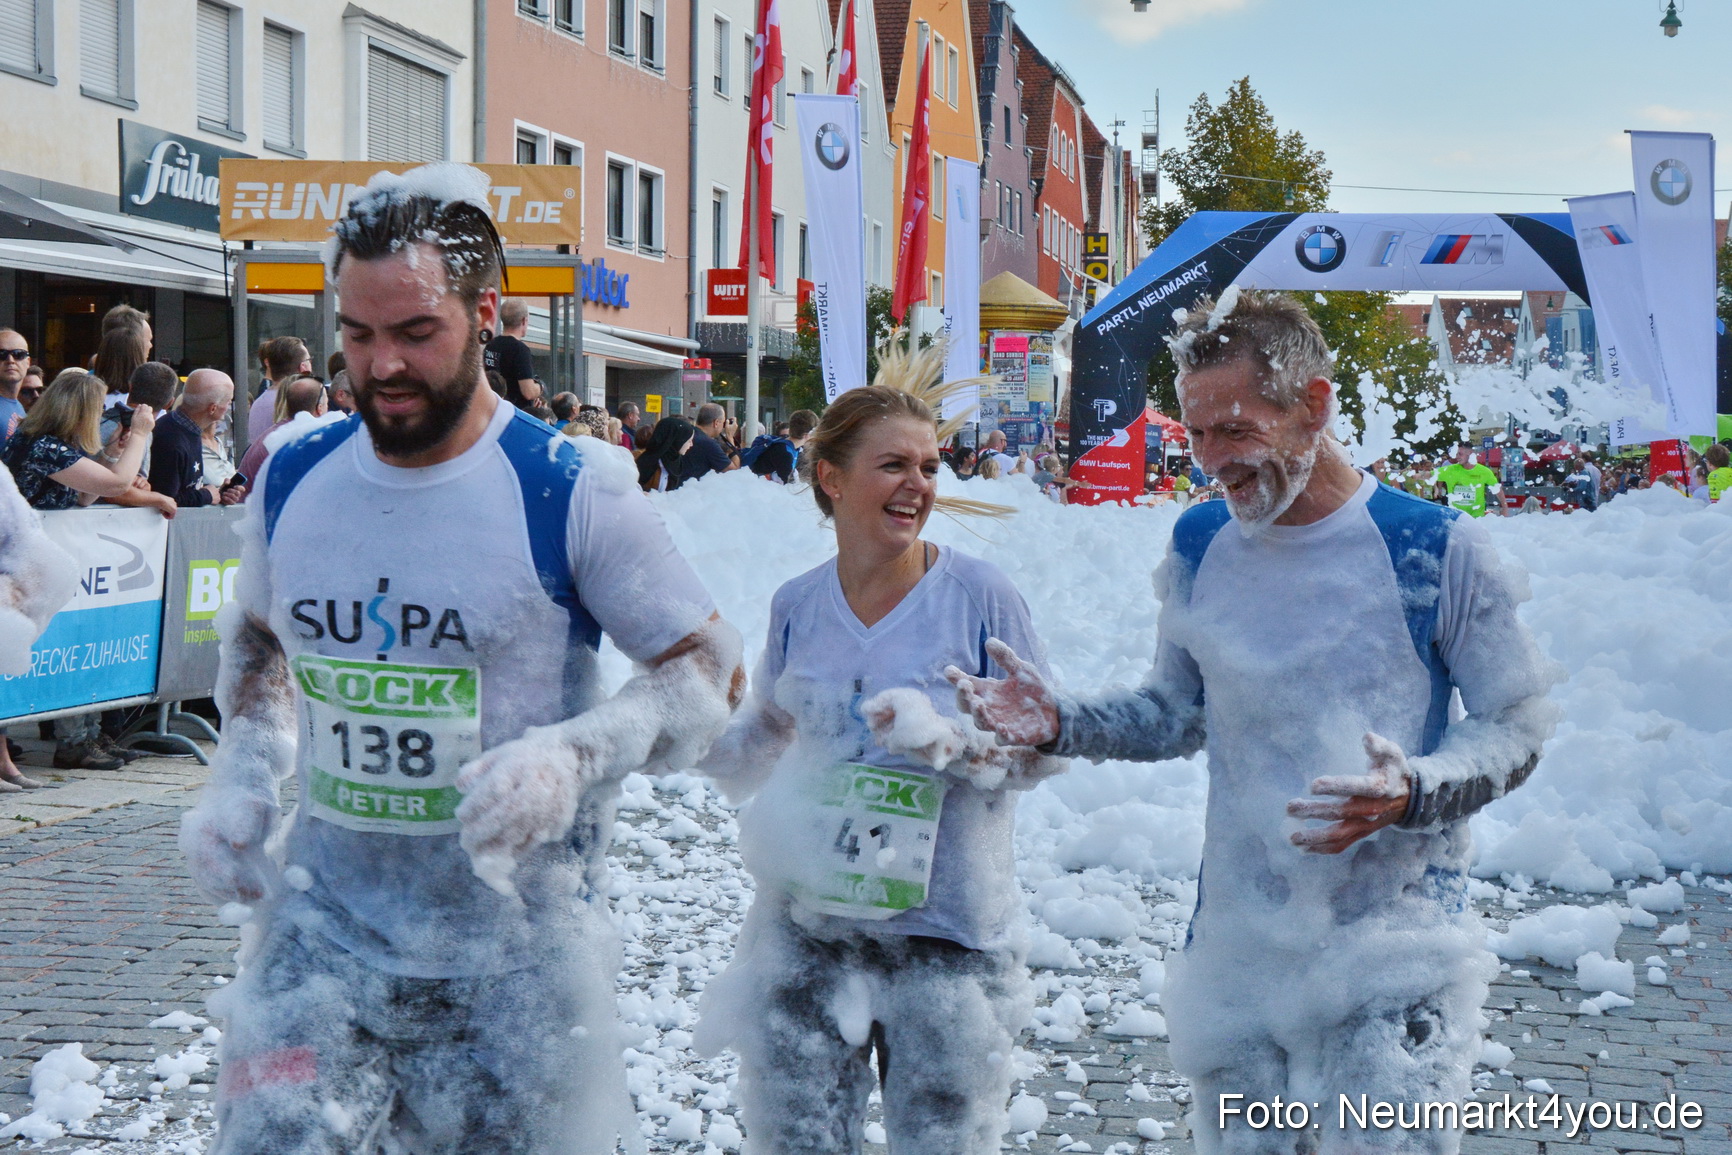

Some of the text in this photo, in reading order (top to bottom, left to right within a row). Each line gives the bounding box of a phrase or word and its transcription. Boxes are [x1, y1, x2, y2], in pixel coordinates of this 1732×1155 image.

[131, 140, 220, 205] früha
[713, 284, 746, 296] WITT
[1096, 261, 1209, 336] PARTL NEUMARKT
[1079, 459, 1131, 470] BMW Laufsport
[291, 578, 475, 660] SUSPA
[81, 634, 149, 670] ZUHAUSE
[331, 720, 436, 779] 138
[337, 785, 427, 816] PETER
